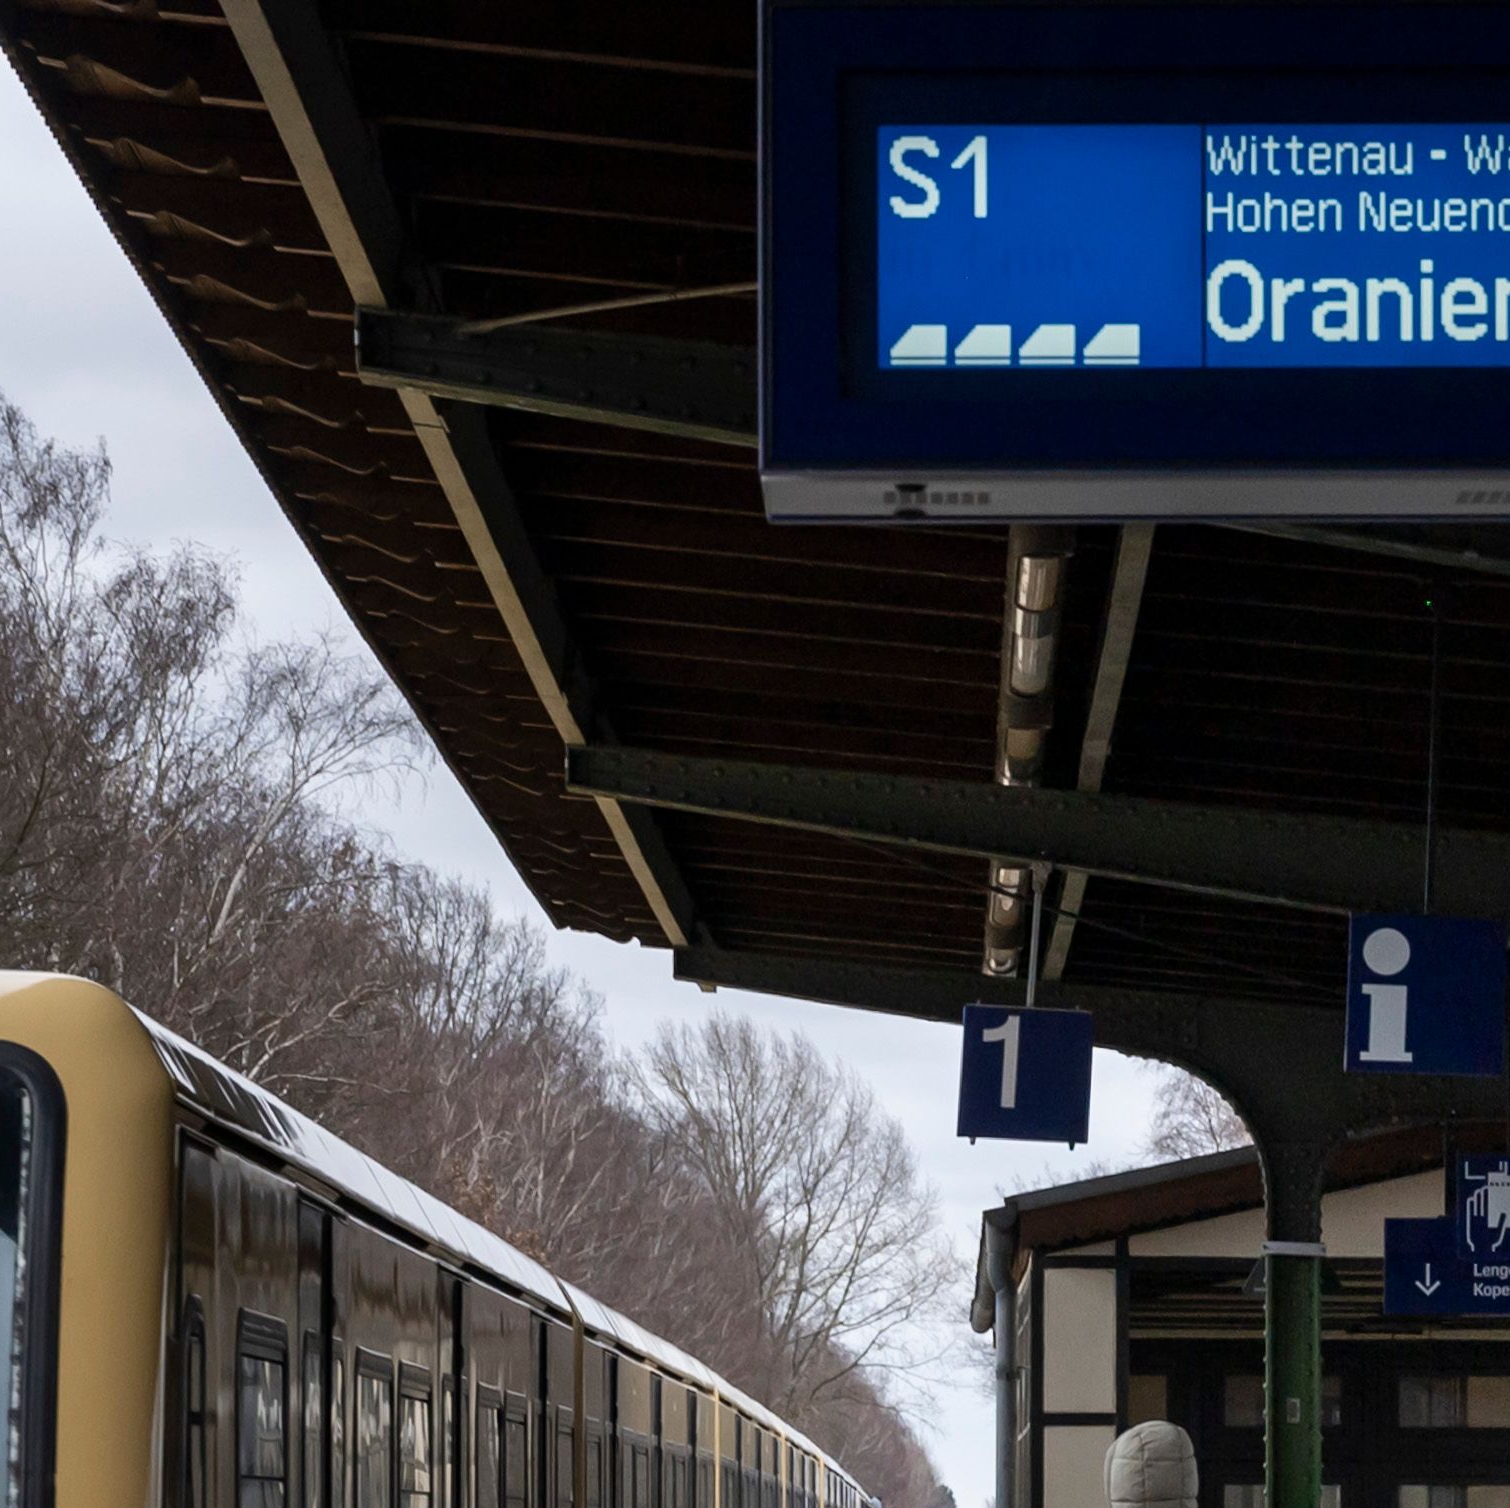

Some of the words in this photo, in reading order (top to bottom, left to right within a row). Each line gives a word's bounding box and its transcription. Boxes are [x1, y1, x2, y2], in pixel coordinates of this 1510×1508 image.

[889, 135, 988, 219] S1
[1206, 134, 1413, 176] Wittenau
[1206, 190, 1342, 233] Hohen
[982, 1014, 1021, 1109] 1
